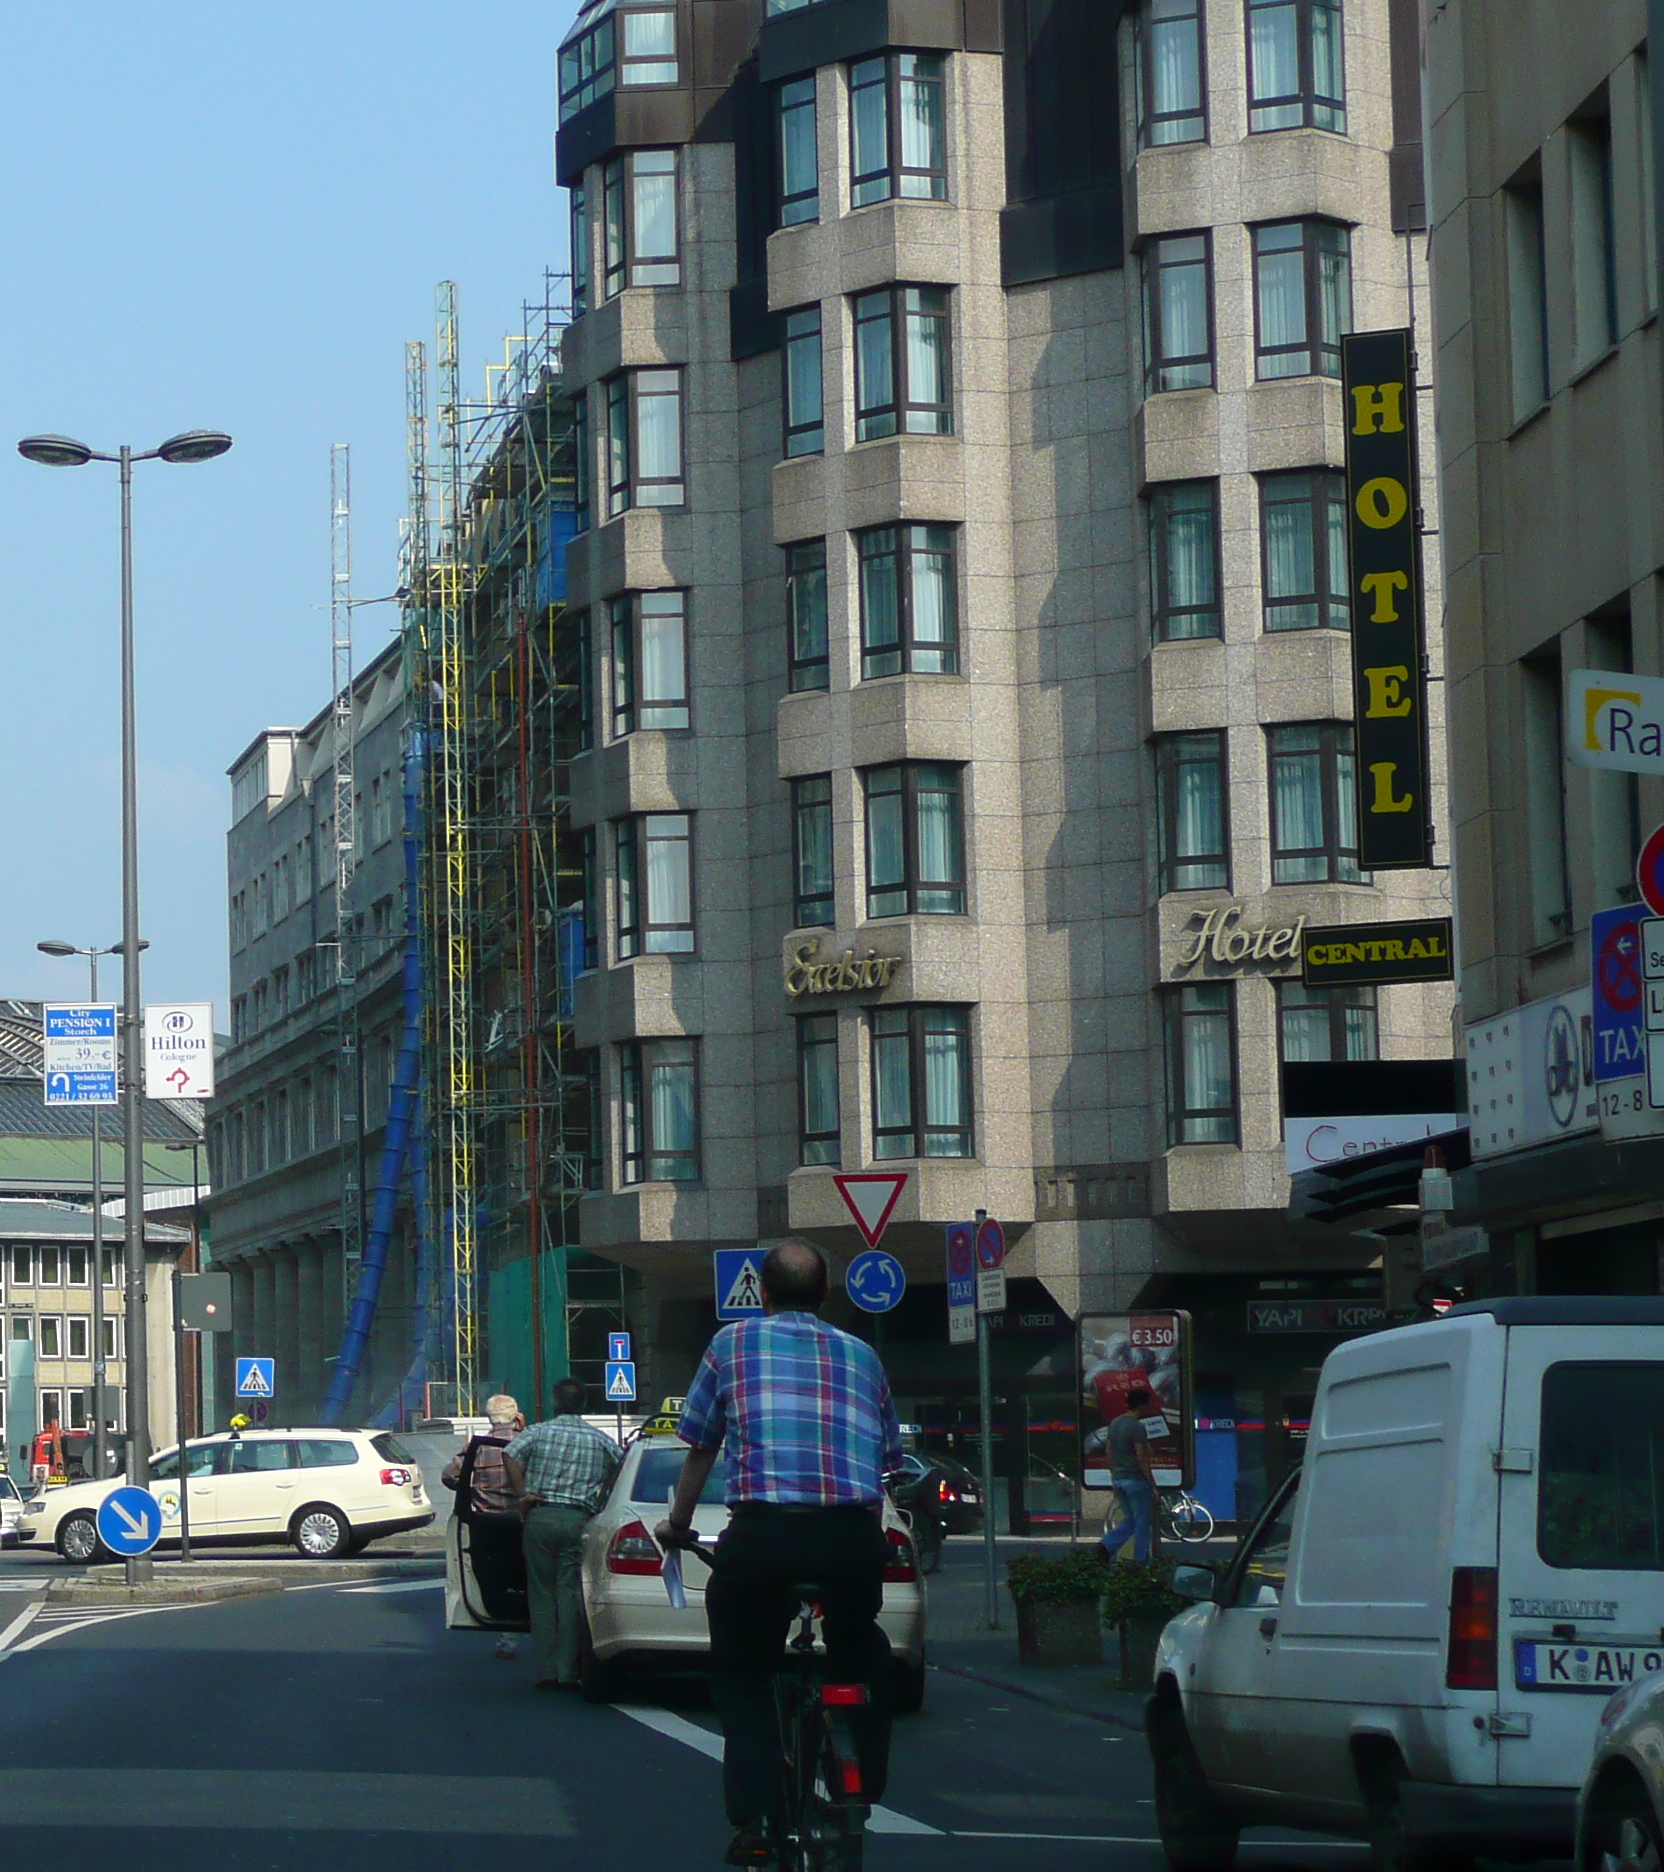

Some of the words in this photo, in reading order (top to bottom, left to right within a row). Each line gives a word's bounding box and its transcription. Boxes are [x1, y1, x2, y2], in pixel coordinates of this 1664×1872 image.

[1351, 382, 1413, 813] HOTEL
[1179, 906, 1307, 963] Hotel
[1307, 937, 1446, 966] CENTRAL
[787, 939, 901, 1001] Excelsior
[50, 1018, 102, 1028] PENSION
[69, 1009, 91, 1018] City
[64, 1028, 97, 1036] Storch
[151, 1035, 206, 1050] Hilton
[1599, 1025, 1645, 1064] TAX
[160, 1053, 197, 1062] Cologne
[950, 1280, 972, 1300] TAXI
[1019, 1315, 1055, 1327] KREDI
[1254, 1308, 1303, 1327] YAPI
[1132, 1330, 1142, 1345] €
[1144, 1328, 1172, 1345] 3.50
[1509, 1599, 1619, 1620] RENAULT
[1548, 1649, 1570, 1680] K
[1594, 1651, 1635, 1682] AW
